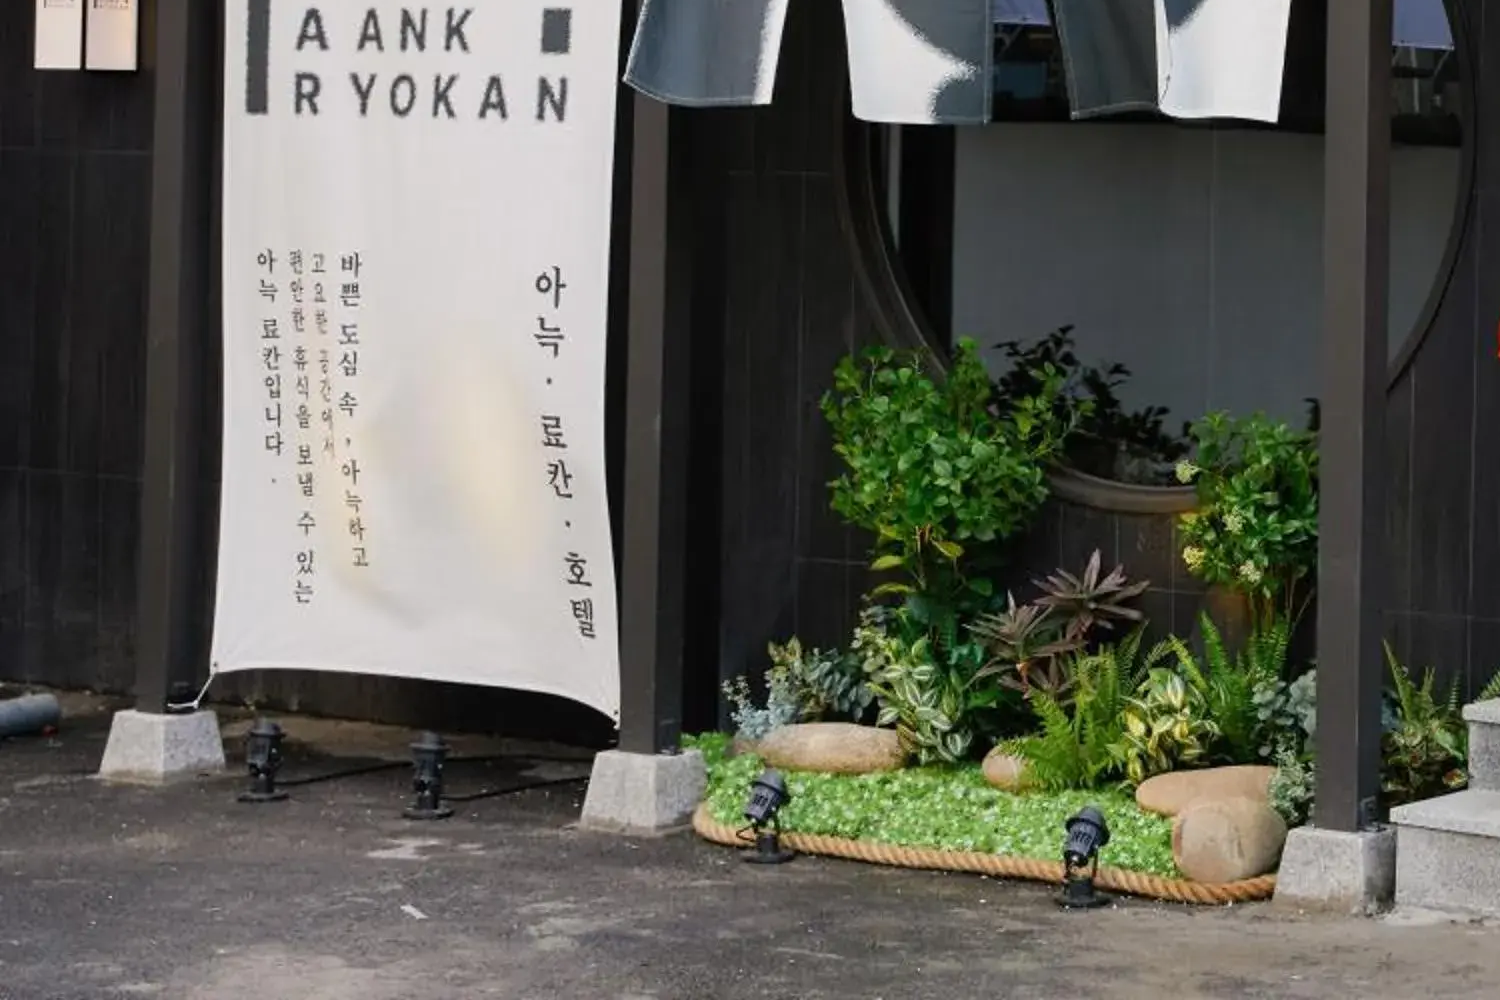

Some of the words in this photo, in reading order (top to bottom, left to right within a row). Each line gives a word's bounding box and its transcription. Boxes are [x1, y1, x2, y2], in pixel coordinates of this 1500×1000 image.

[296, 7, 474, 53] AANK
[293, 72, 570, 123] RYOKAN
[256, 248, 279, 304] 아늑
[339, 252, 363, 307] 바쁜
[338, 324, 360, 377] 도심
[294, 345, 312, 429] 휴식을
[297, 444, 314, 497] 보낼
[297, 511, 316, 536] 수
[294, 549, 314, 604] 있는
